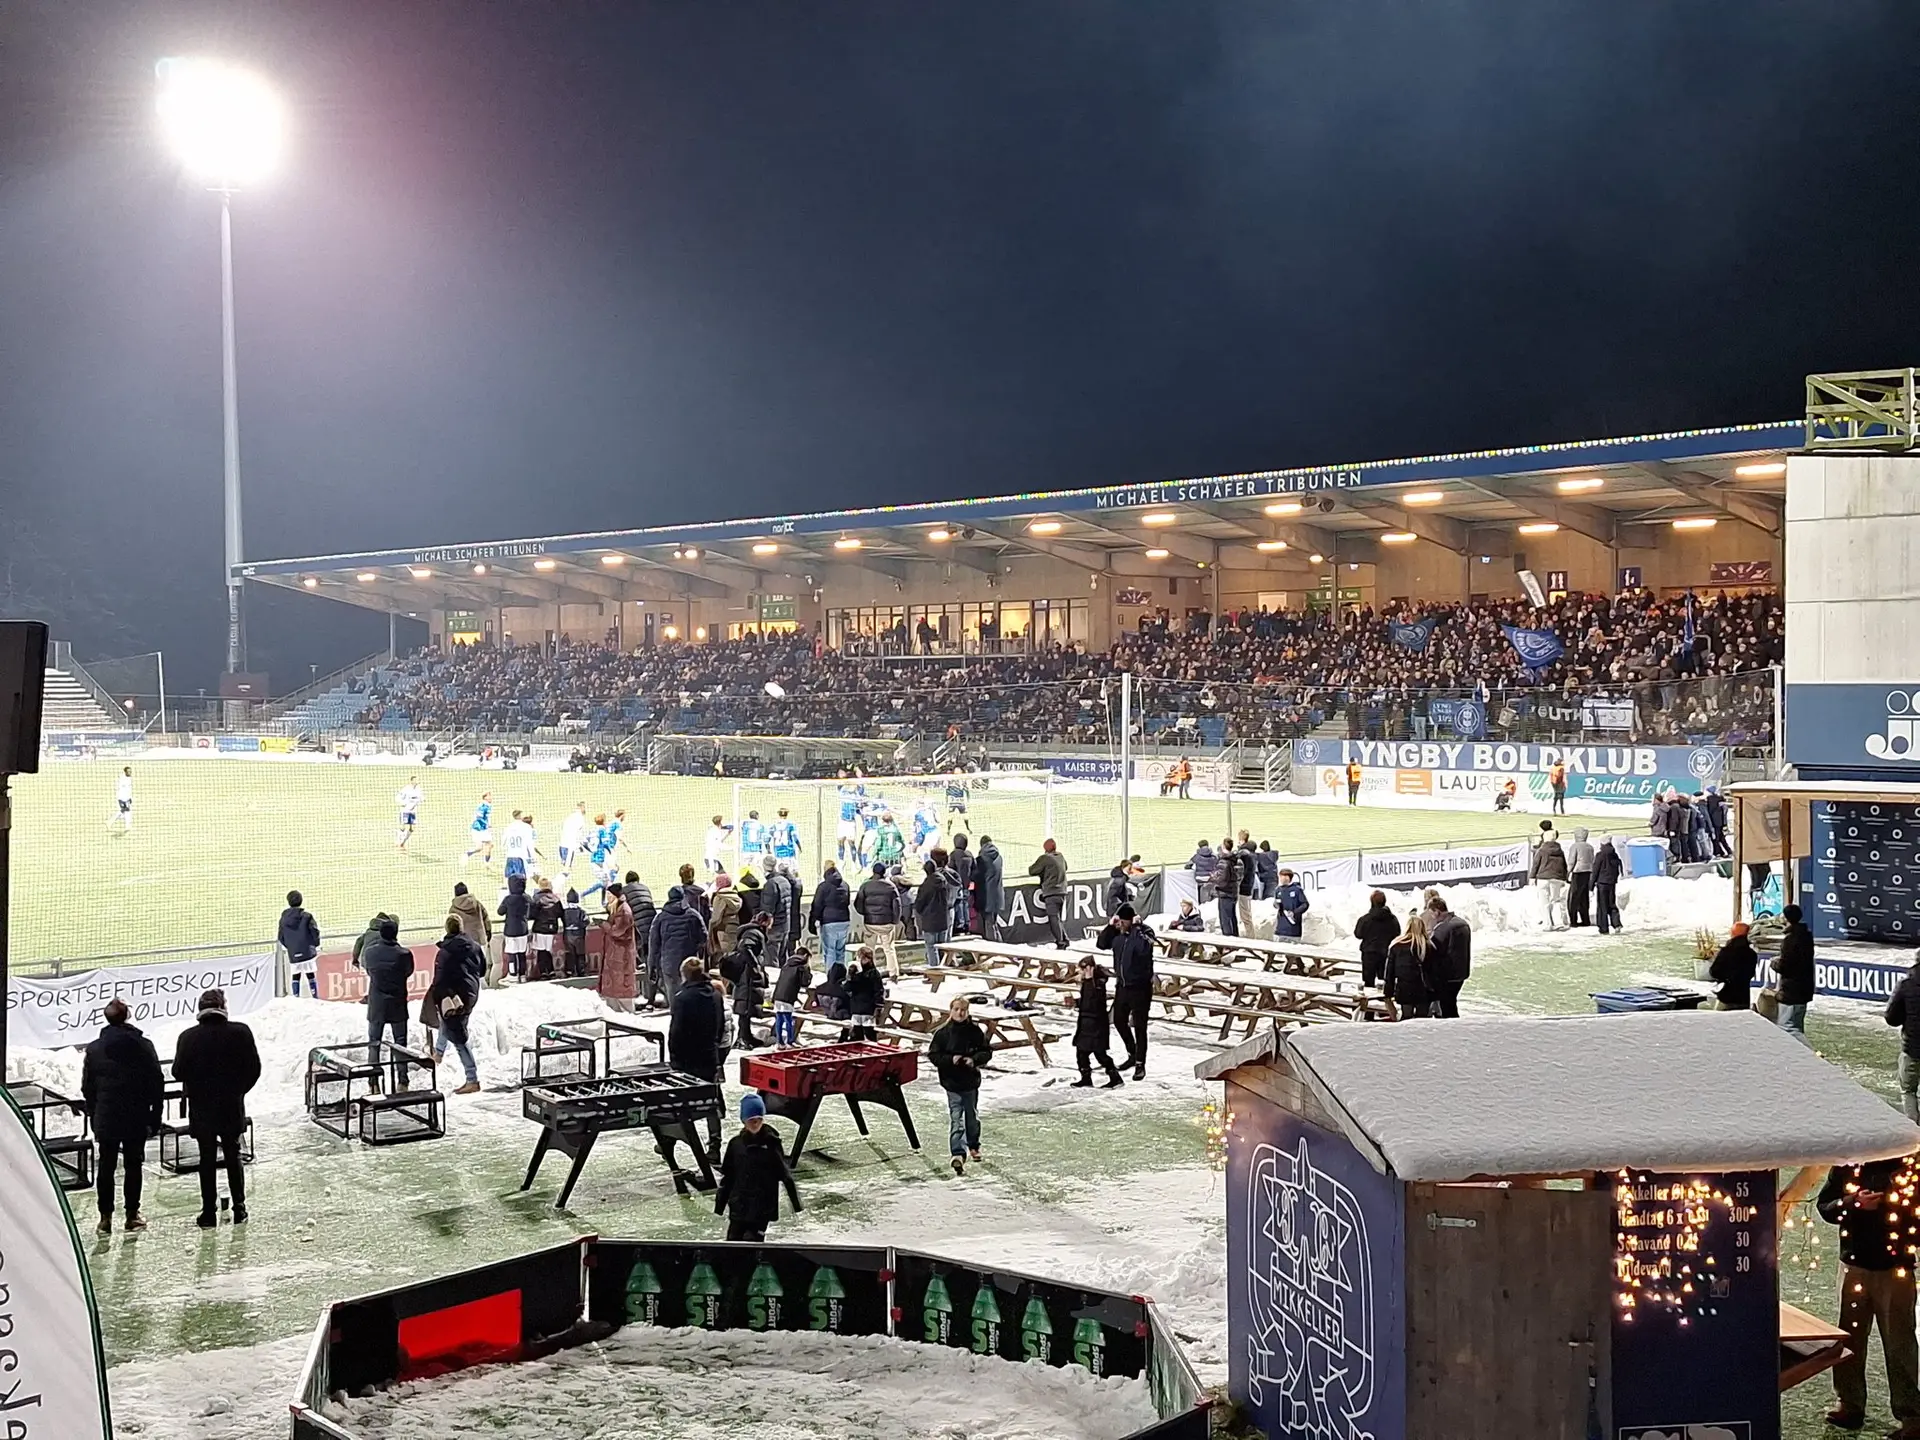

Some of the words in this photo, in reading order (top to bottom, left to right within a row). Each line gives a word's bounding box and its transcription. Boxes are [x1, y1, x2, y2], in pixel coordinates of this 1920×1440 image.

[1096, 489, 1169, 508] MICHAEL
[1266, 471, 1362, 493] TRIBUNEN
[414, 550, 451, 562] MICHAEL
[499, 543, 545, 556] TRIBUNEN
[1065, 761, 1096, 772] KAISER
[1099, 762, 1122, 773] SPOR
[1342, 740, 1464, 768] LYNGBY
[1473, 744, 1656, 775] BOLDKLUB
[1639, 780, 1653, 795] &
[1371, 860, 1416, 876] MÅLRETTET
[1419, 859, 1445, 872] MODE
[1449, 858, 1458, 871] TIL
[1460, 857, 1482, 869] BØRN
[1485, 855, 1496, 868] OG
[1498, 851, 1520, 866] UNGE
[57, 998, 197, 1031] SJÆØLUN
[1736, 1182, 1749, 1198] 55
[1667, 1209, 1674, 1225] 6
[1676, 1214, 1683, 1224] x
[1729, 1207, 1749, 1222] 300
[1736, 1231, 1750, 1247] 30
[1736, 1256, 1750, 1273] 30
[706, 1295, 715, 1326] SPORT
[768, 1297, 776, 1328] SPORT
[829, 1299, 838, 1330] SPORT
[1273, 1276, 1341, 1349] MIKKELLER
[988, 1322, 996, 1354] SPORT
